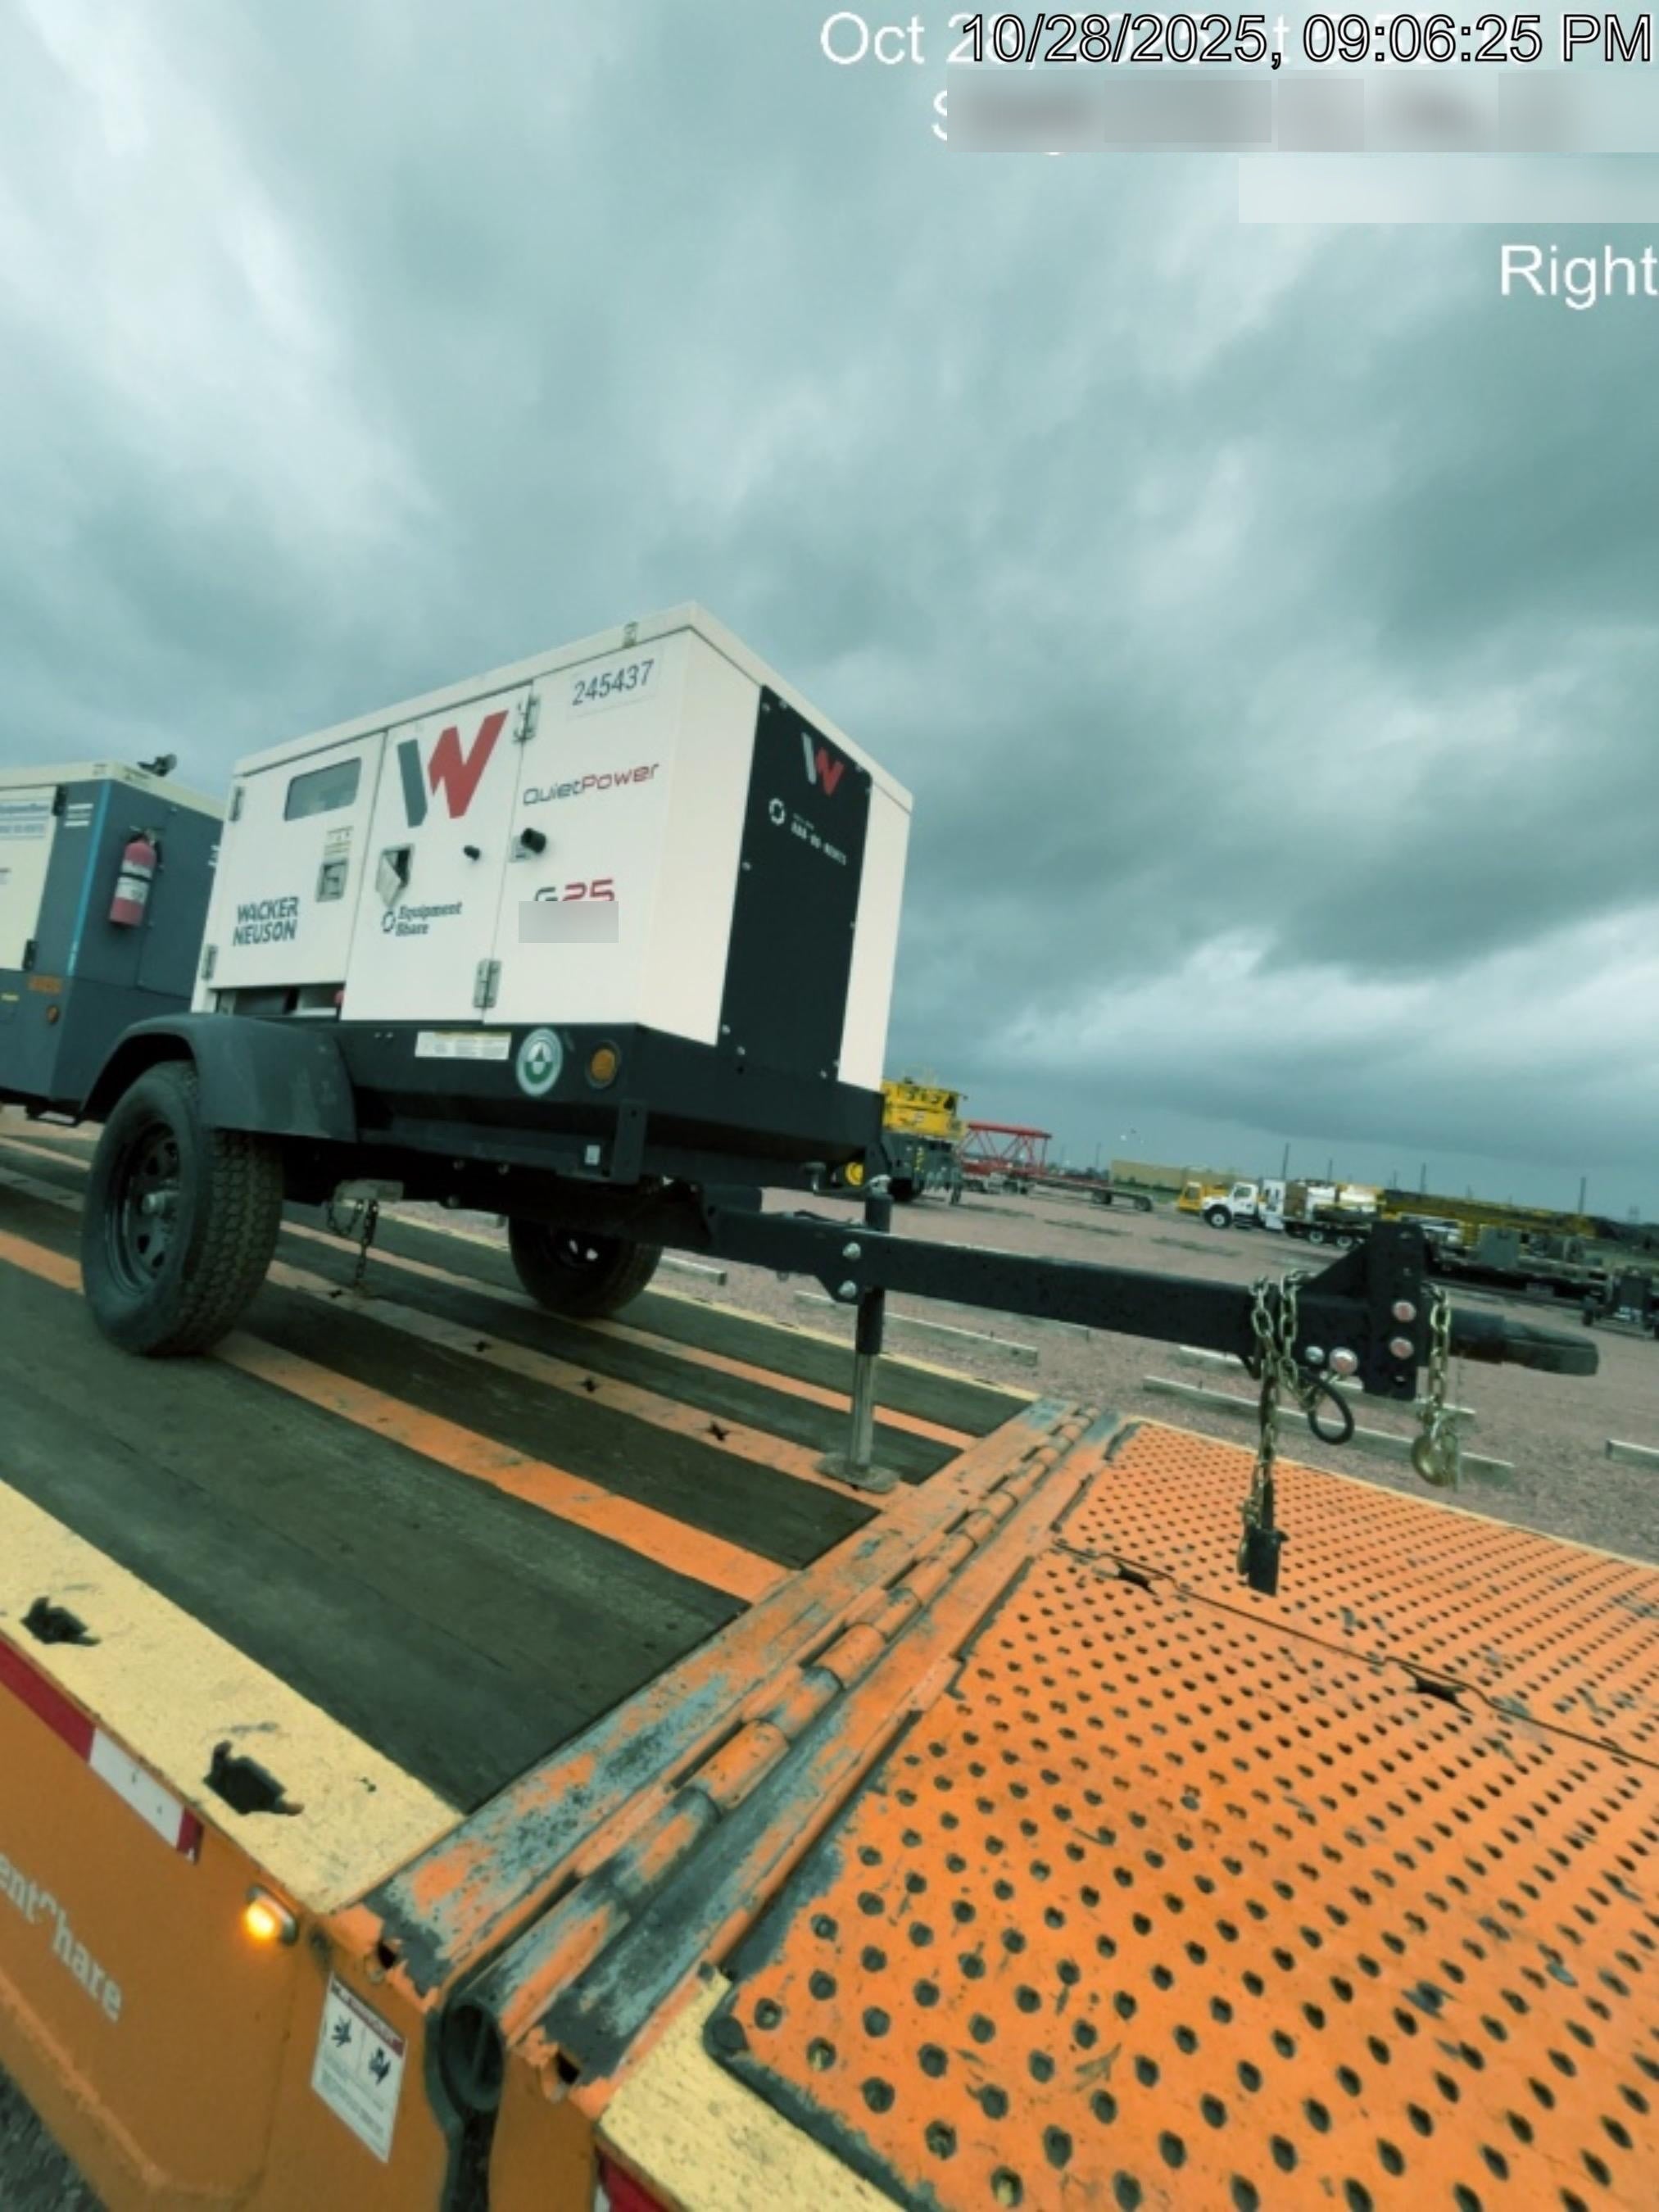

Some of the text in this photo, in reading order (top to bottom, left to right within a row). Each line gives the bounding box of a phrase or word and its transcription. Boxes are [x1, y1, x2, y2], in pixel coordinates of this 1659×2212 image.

[571, 658, 655, 706] 245437
[522, 763, 660, 806] QuietPower
[237, 895, 300, 925] WACKER
[232, 918, 298, 946] NEUSON
